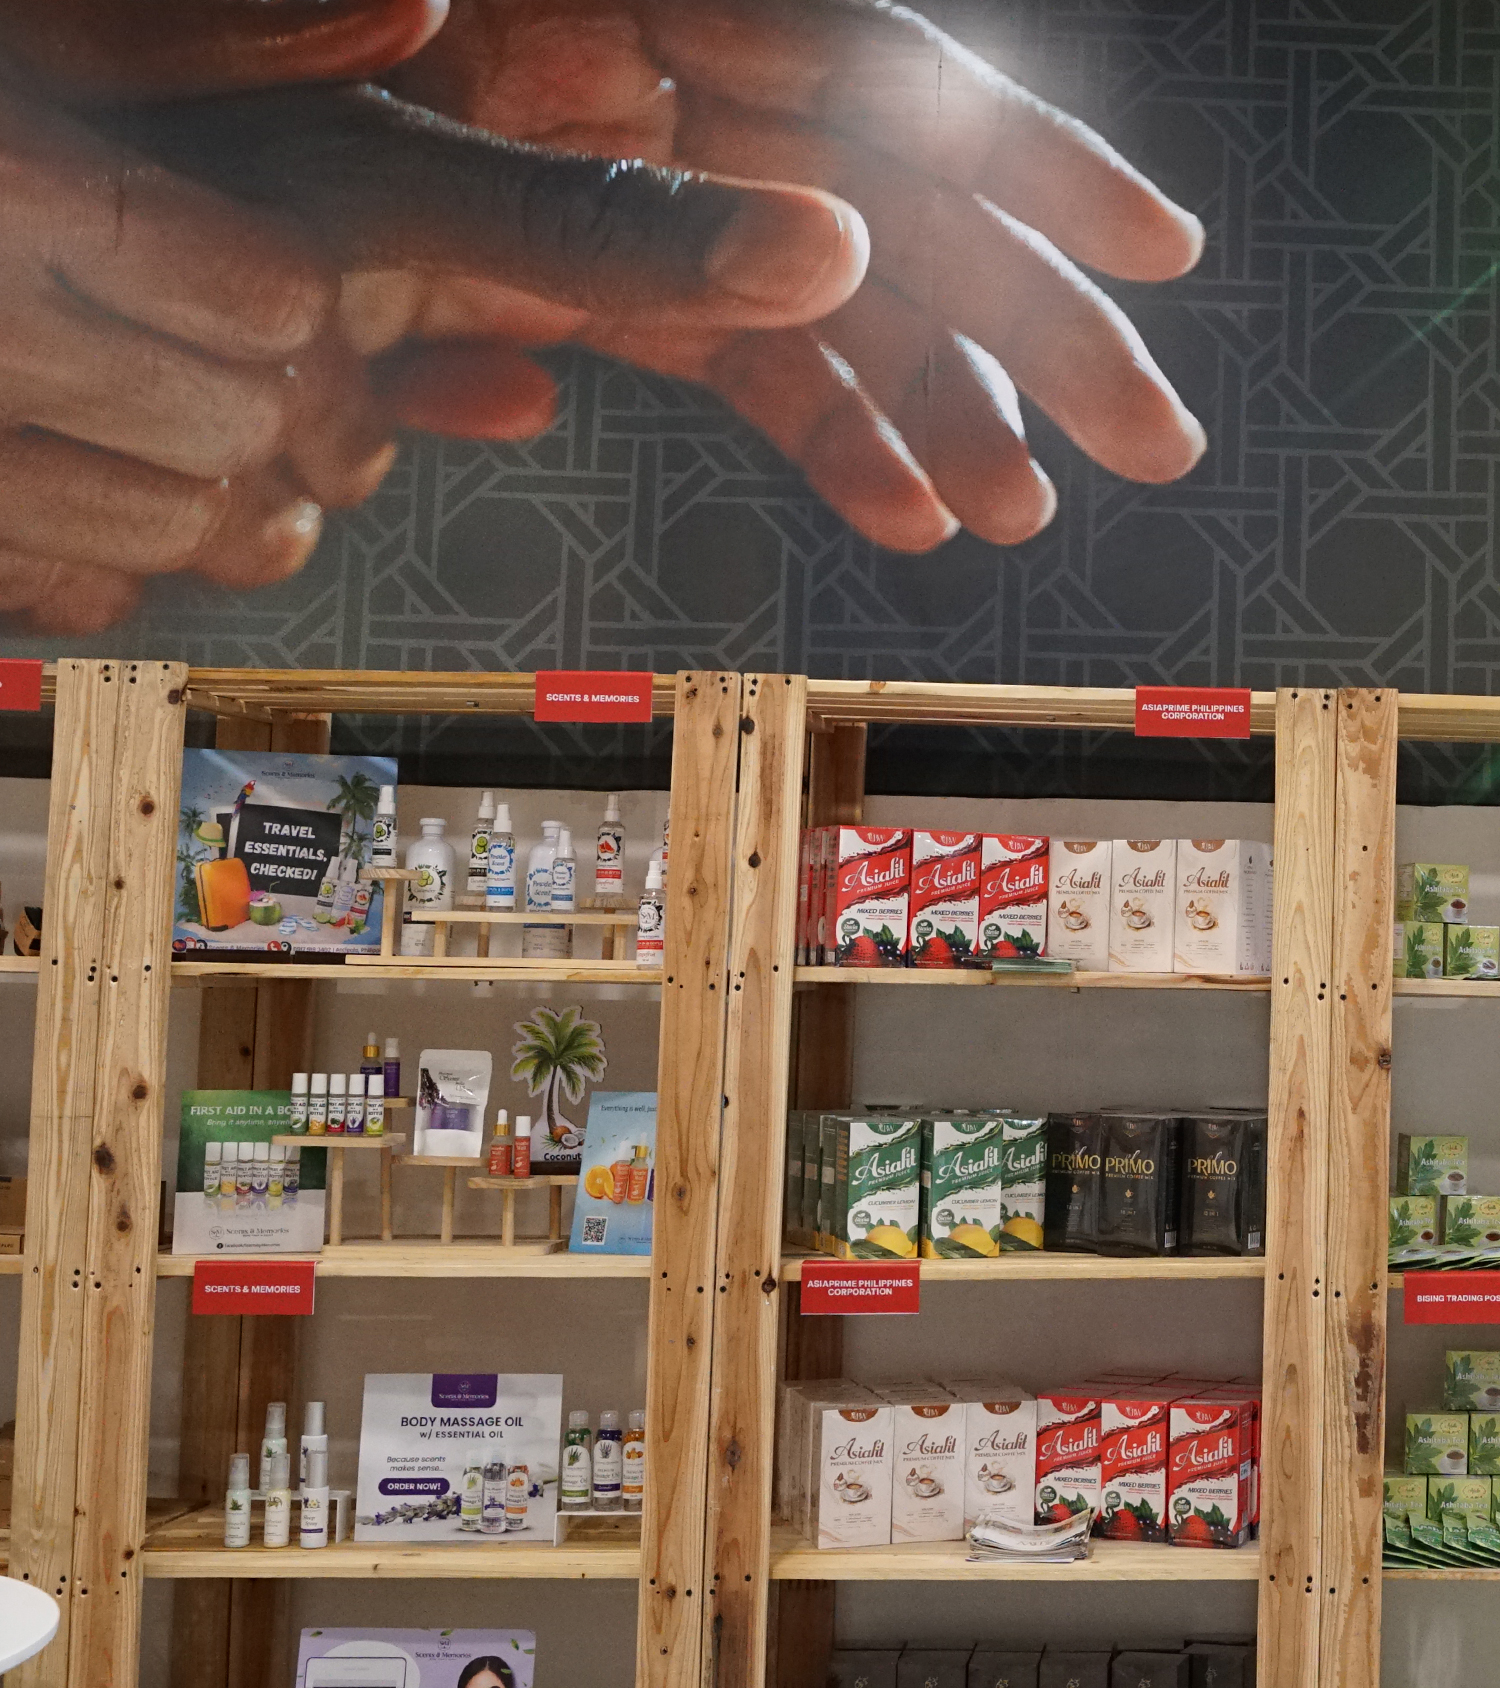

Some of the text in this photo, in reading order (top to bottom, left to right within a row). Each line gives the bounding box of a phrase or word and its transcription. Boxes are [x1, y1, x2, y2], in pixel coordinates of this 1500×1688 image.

[545, 693, 639, 704] SCENTS & MEMORIES
[1142, 703, 1244, 713] ASIAPRIME PHILIPPINES
[1161, 712, 1225, 720] CORPORATION
[263, 822, 316, 839] TRAVEL
[244, 841, 327, 862] ESSENTIALS,
[250, 862, 317, 880] CHECKED!
[190, 1106, 222, 1116] FIRST
[225, 1105, 246, 1115] AID
[249, 1105, 262, 1115] IN
[264, 1105, 273, 1115] A
[206, 1118, 226, 1127] Bring
[543, 1152, 582, 1162] Coconut
[1052, 1153, 1100, 1170] PRIMO
[1105, 1155, 1155, 1175] PRIMO
[1187, 1157, 1237, 1175] PRIMO
[807, 1279, 913, 1288] ASIAPRIME PHILIPPINES
[205, 1285, 242, 1293] SCENTS
[251, 1285, 301, 1293] MEMORIES
[827, 1287, 893, 1296] CORPORATION
[401, 1416, 524, 1427] BODY MASSAGE OIL
[419, 1430, 503, 1439] w/ ESSENTIAL OIL
[387, 1455, 446, 1463] Because scents
[387, 1482, 441, 1491] ORDER NOW!
